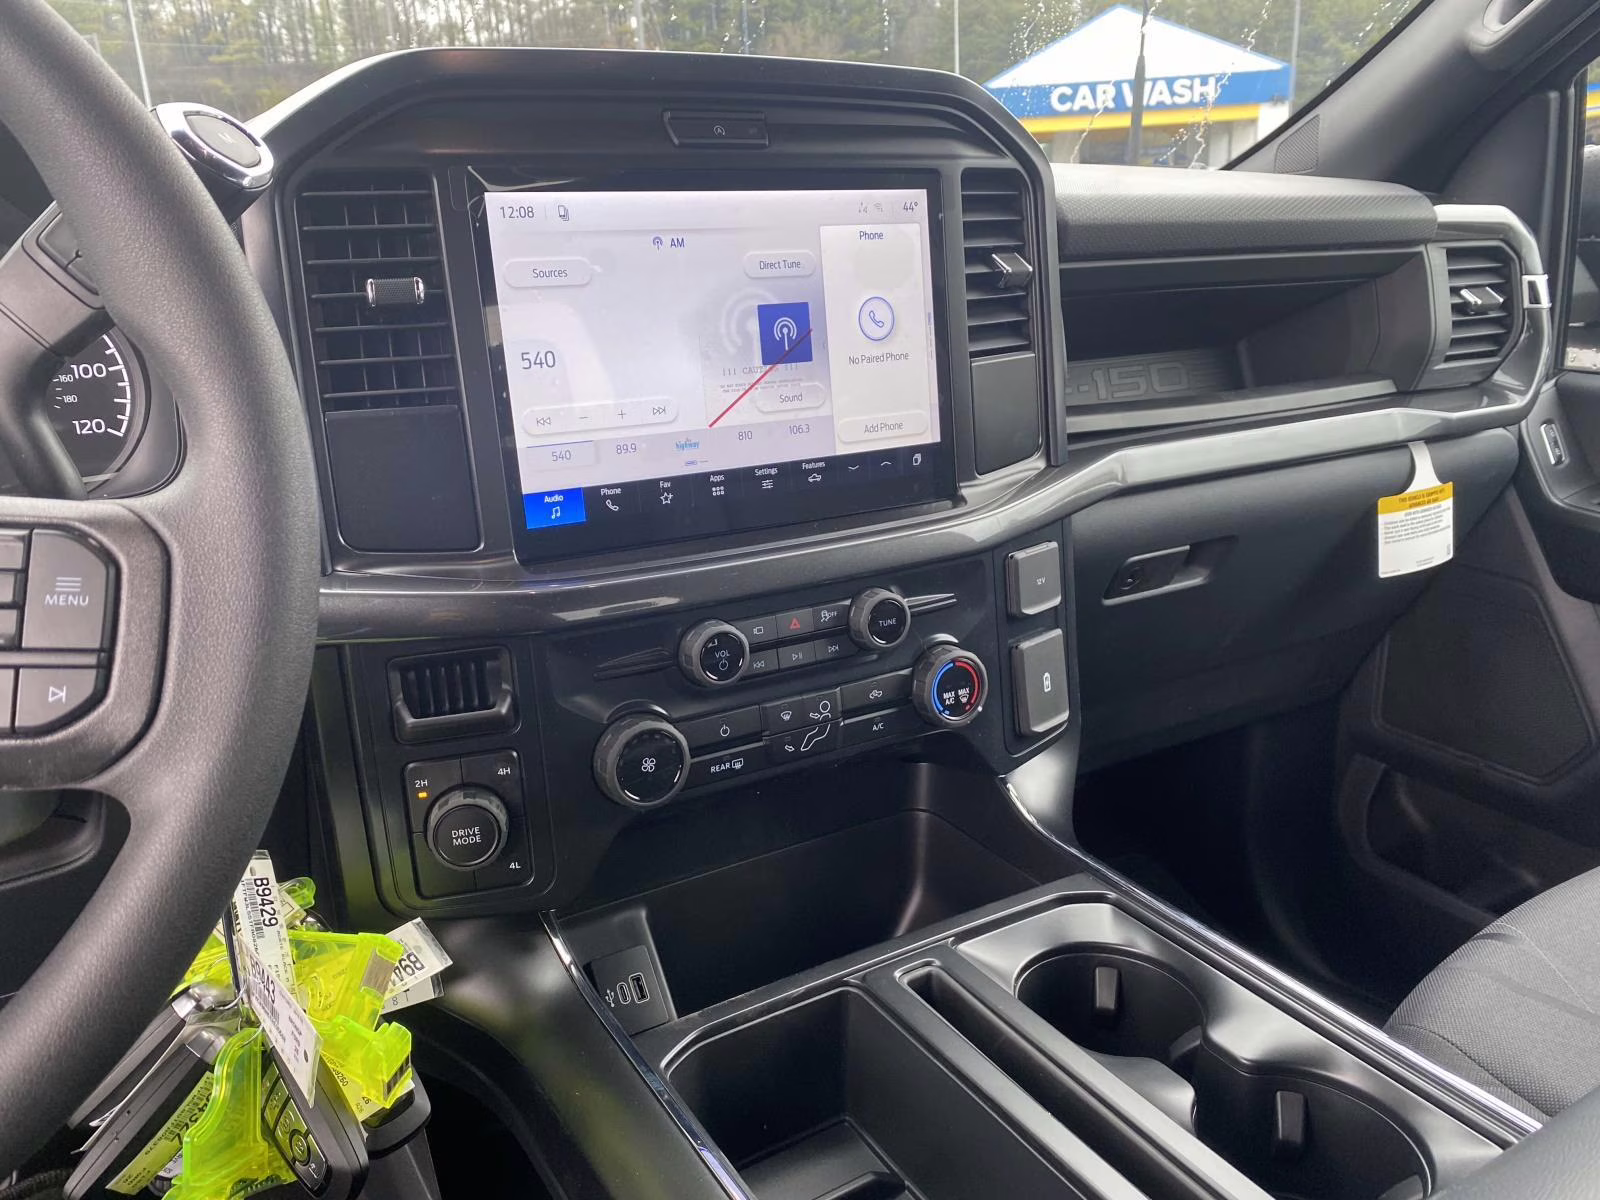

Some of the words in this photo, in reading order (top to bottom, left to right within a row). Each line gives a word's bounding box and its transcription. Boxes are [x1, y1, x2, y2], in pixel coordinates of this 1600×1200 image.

[1050, 83, 1117, 112] CAR
[1122, 77, 1217, 107] WASH
[499, 206, 535, 219] 12:08
[859, 230, 884, 241] Phone
[670, 237, 685, 249] AM
[759, 260, 782, 270] Direct
[783, 259, 801, 270] Tune
[532, 267, 568, 279] Sources
[520, 350, 556, 370] 540
[848, 355, 860, 365] No
[860, 352, 885, 363] Paired
[885, 351, 909, 362] Phone
[70, 363, 106, 379] 100
[58, 374, 74, 382] 160
[62, 394, 78, 403] 180
[779, 392, 803, 404] Sound
[72, 418, 106, 434] 120
[788, 424, 810, 436] 106.3
[864, 423, 879, 434] Add
[879, 420, 904, 432] Phone
[738, 430, 753, 441] 810
[615, 442, 637, 455] 89.9
[551, 449, 572, 462] 540
[802, 460, 826, 471] Features
[754, 466, 778, 477] Settings
[709, 473, 725, 483] Apps
[659, 480, 671, 489] Fav
[600, 487, 622, 497] Phone
[544, 493, 564, 503] Audio
[44, 594, 89, 607] MENU
[878, 617, 897, 627] TUNE
[714, 649, 731, 658] VOL
[943, 691, 955, 699] MAX
[958, 687, 970, 696] MAX
[872, 722, 885, 731] A/C
[497, 766, 511, 776] 4H
[710, 762, 731, 773] REAR
[414, 779, 428, 788] 2H
[451, 826, 480, 838] DRIVE
[452, 835, 482, 846] MODE
[509, 861, 521, 869] 4L
[253, 877, 279, 928] B9429
